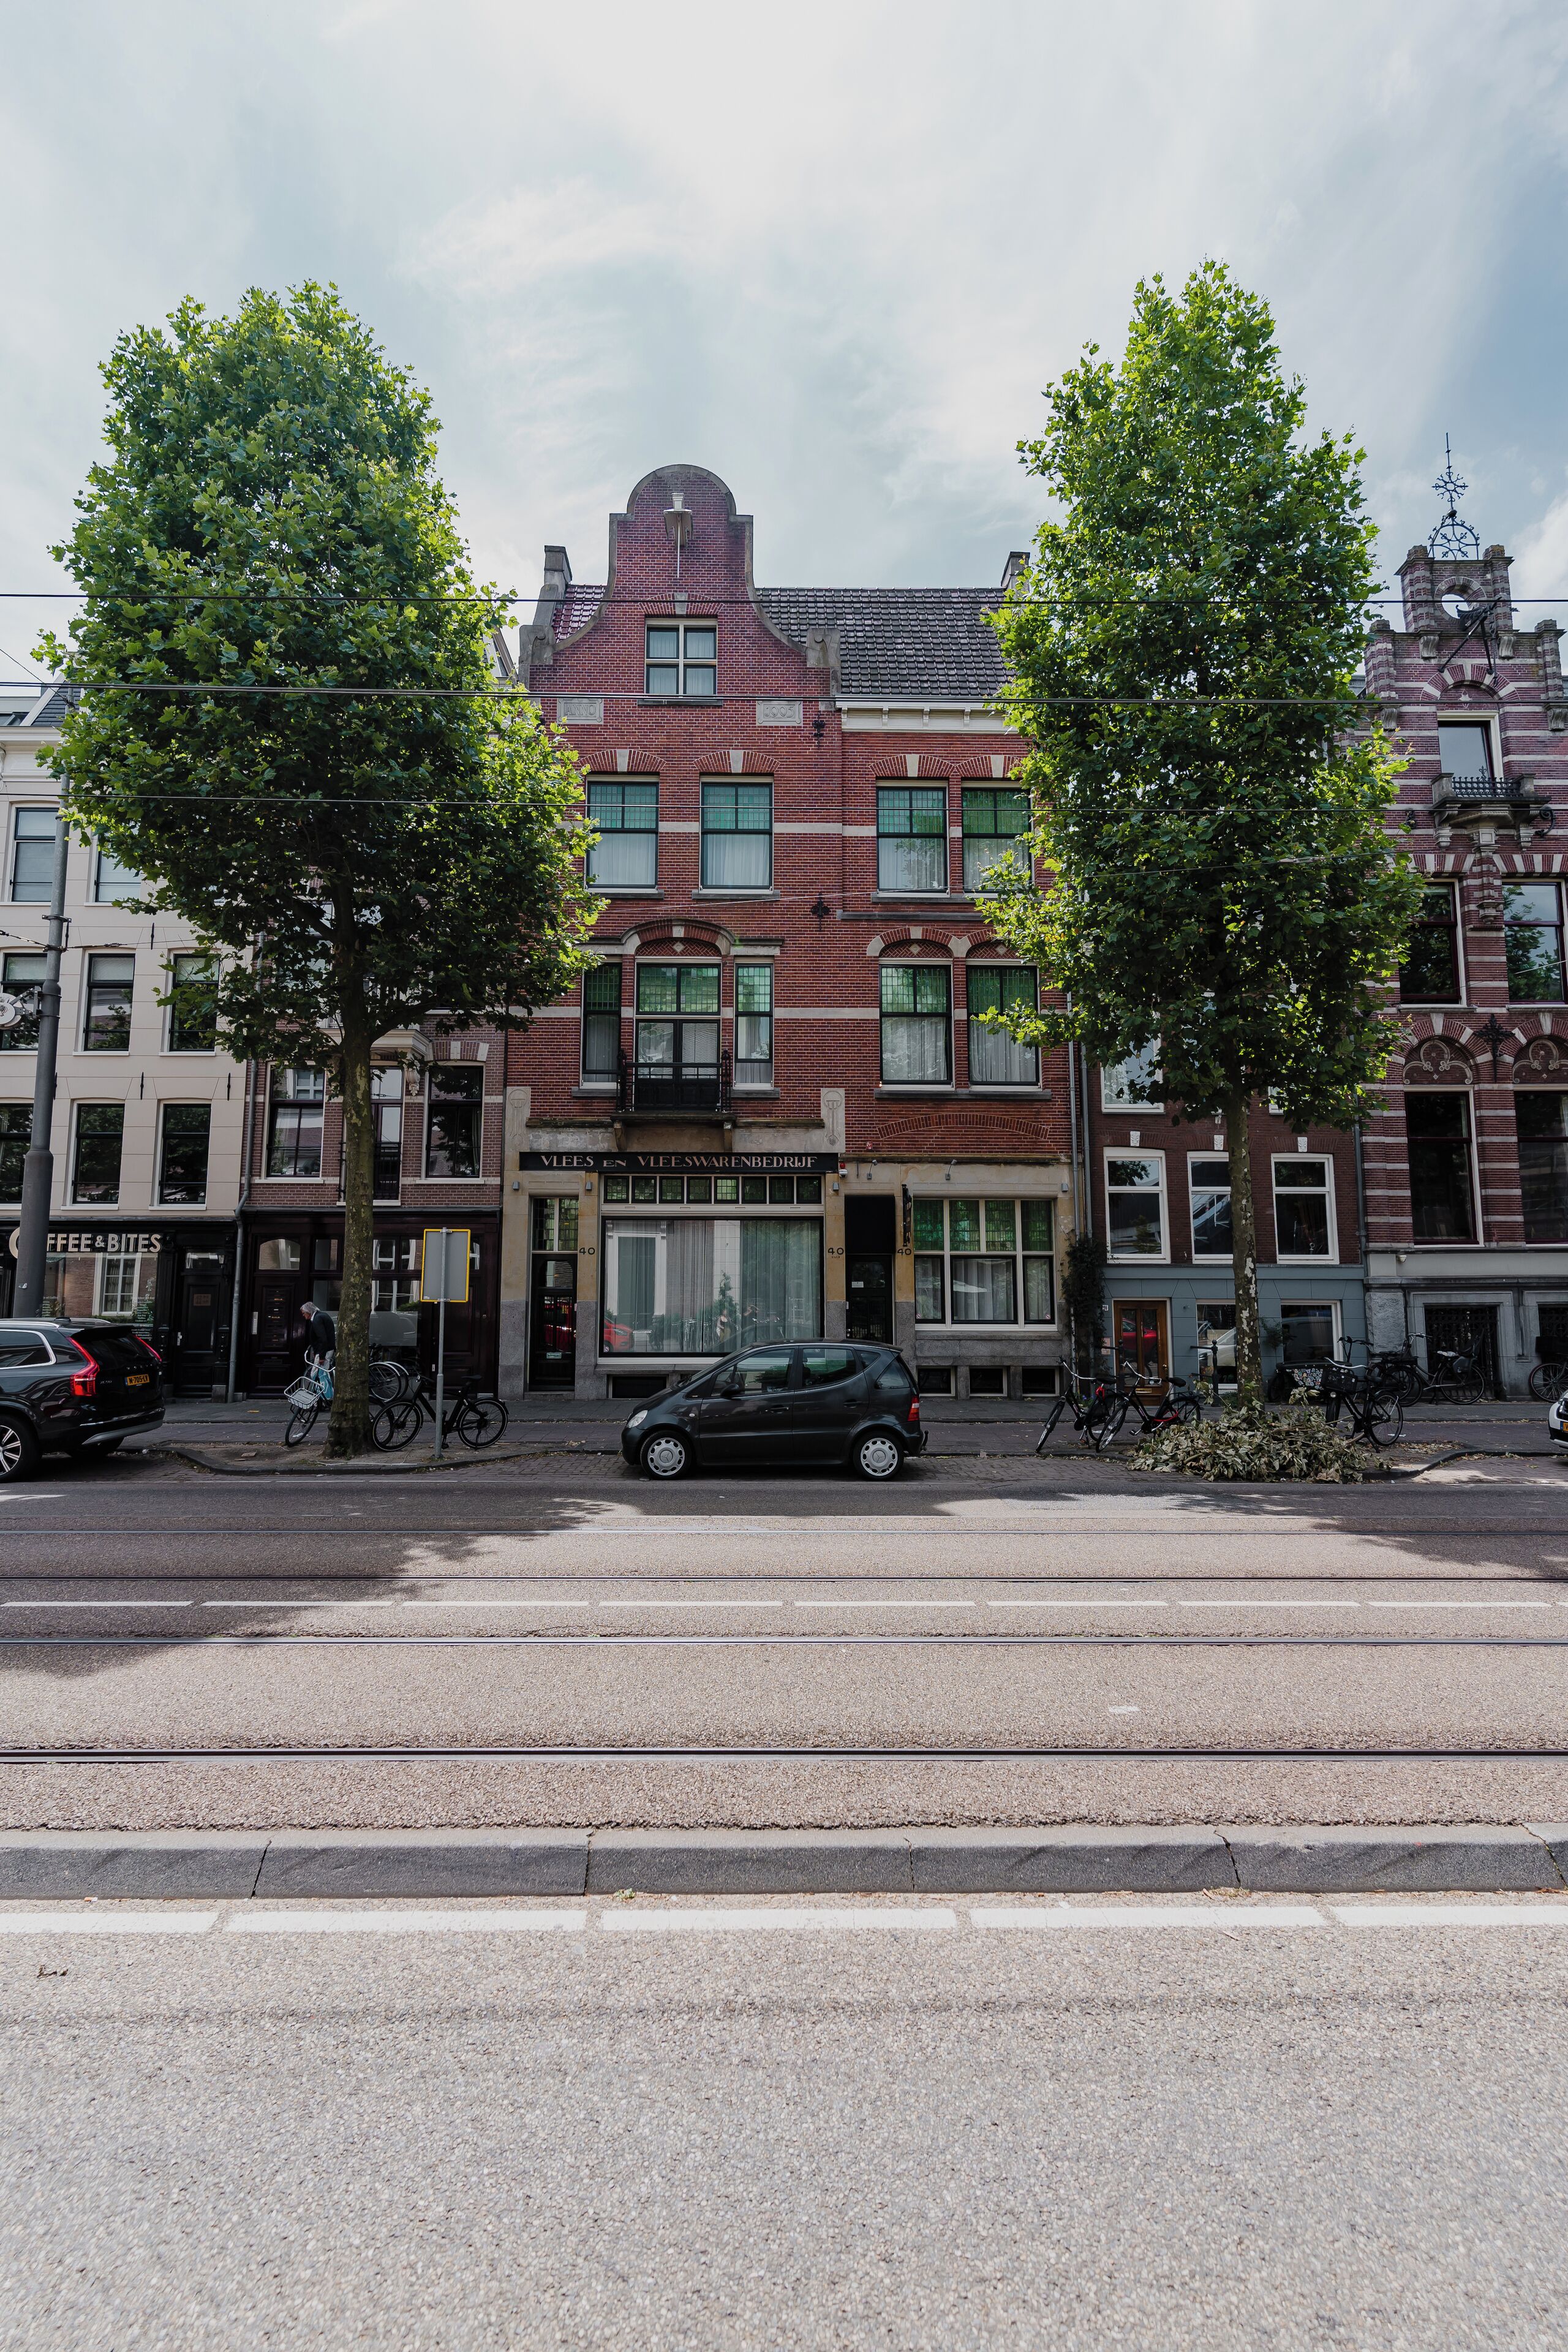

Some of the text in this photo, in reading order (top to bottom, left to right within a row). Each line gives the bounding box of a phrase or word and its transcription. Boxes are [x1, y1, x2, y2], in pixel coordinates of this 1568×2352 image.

[565, 704, 596, 715] ANNO
[764, 706, 794, 718] 1905
[541, 1155, 594, 1167] VLEES
[638, 1156, 818, 1167] VLEESWARENBEDRIJF
[9, 1227, 92, 1259] FFEE
